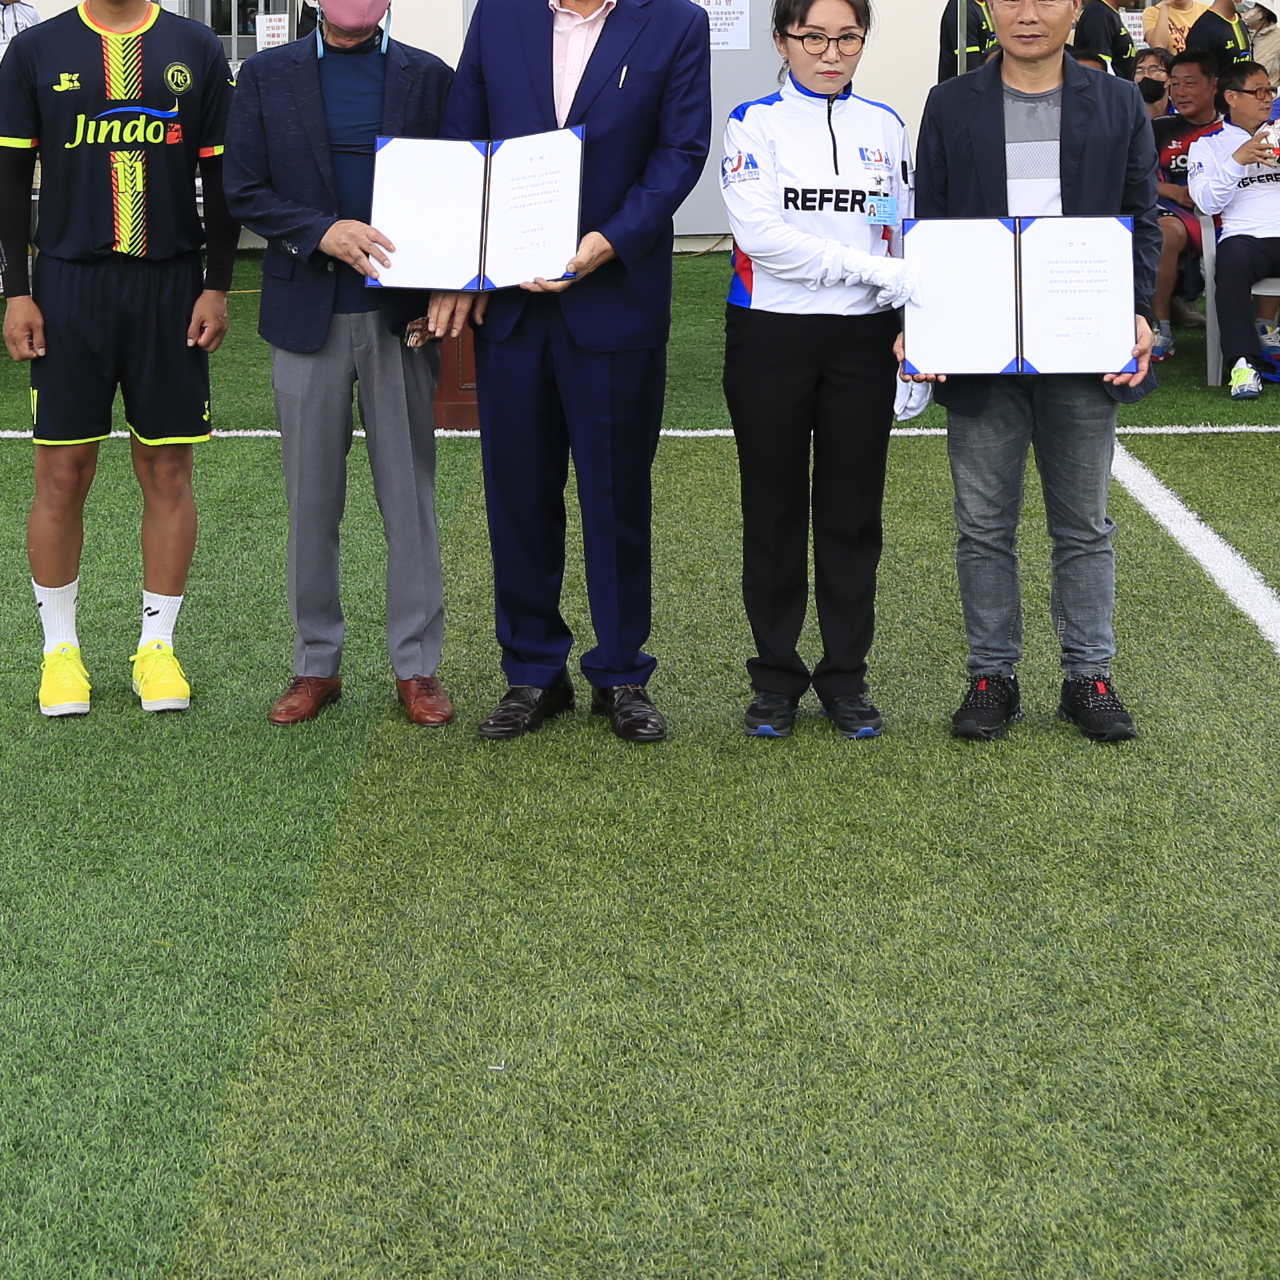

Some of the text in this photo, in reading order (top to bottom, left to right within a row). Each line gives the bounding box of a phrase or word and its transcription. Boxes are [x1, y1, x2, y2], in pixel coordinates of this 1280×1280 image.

[64, 113, 165, 149] Jindo
[113, 161, 144, 193] 11
[783, 186, 889, 214] REFER
